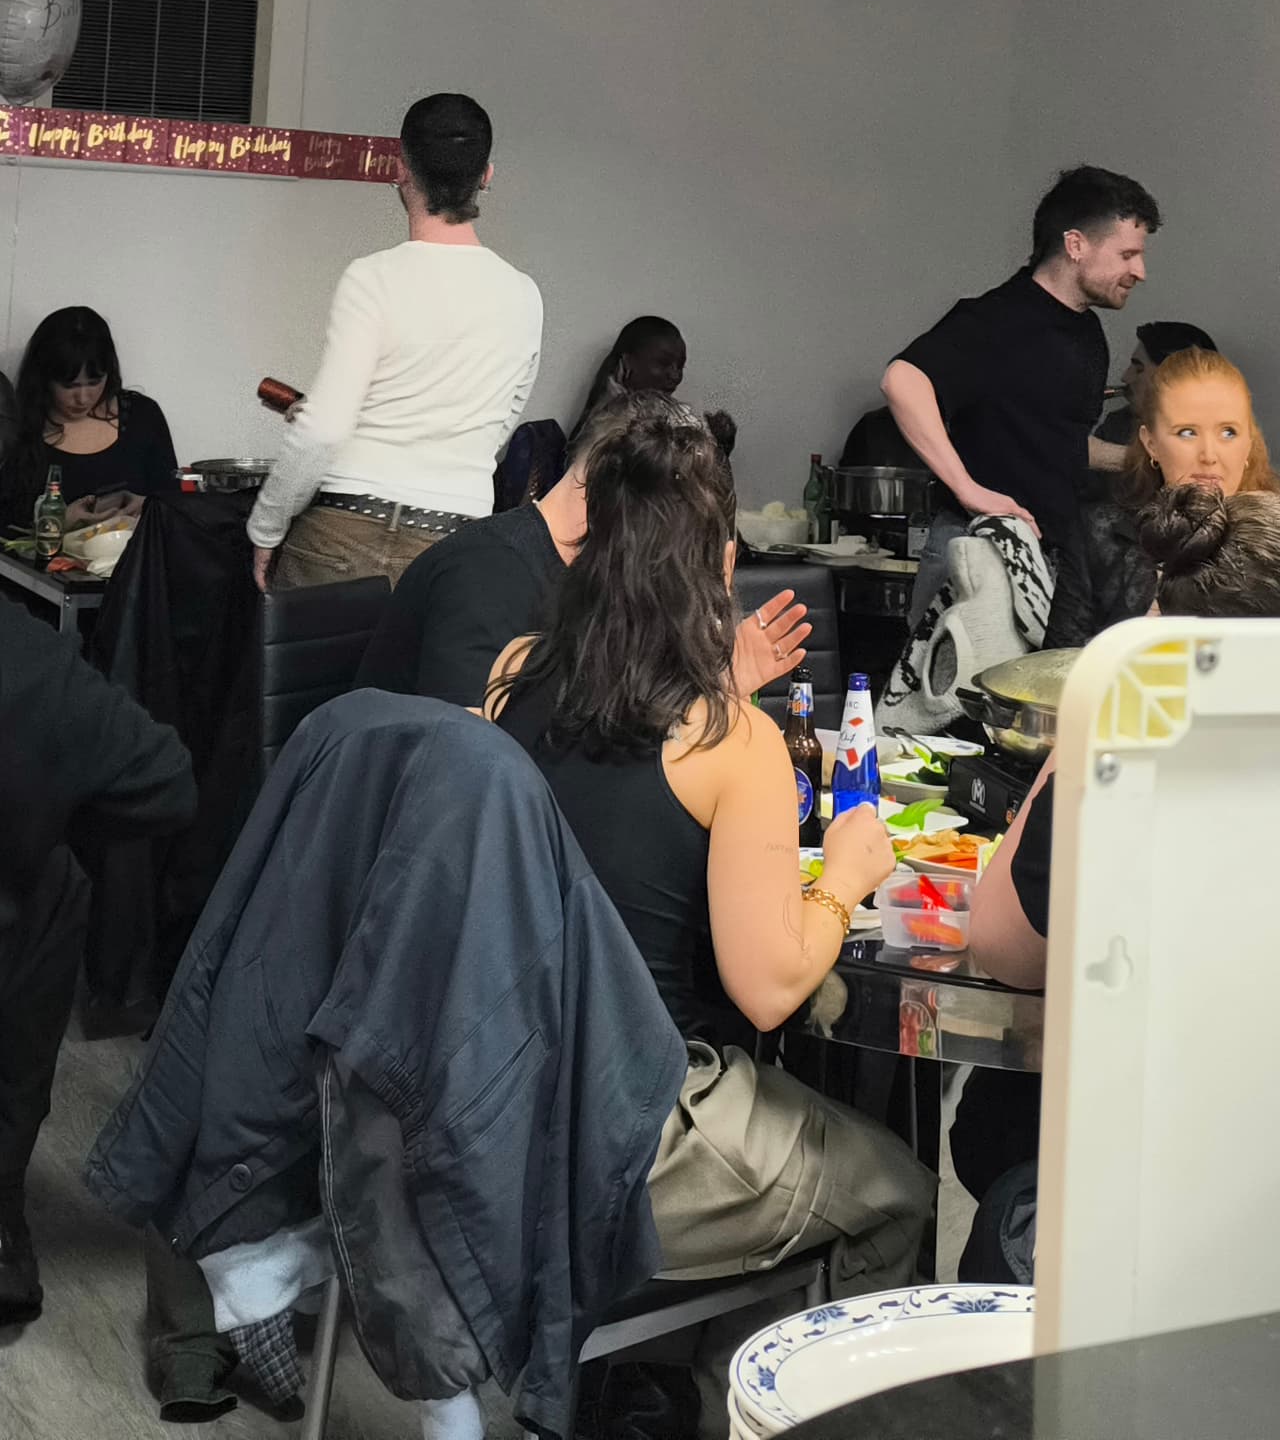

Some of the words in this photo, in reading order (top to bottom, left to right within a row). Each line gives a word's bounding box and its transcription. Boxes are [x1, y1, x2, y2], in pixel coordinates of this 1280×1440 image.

[28, 123, 80, 152] Happy
[87, 122, 154, 150] Birthday
[174, 134, 224, 163] Happy
[230, 133, 291, 161] Birthday
